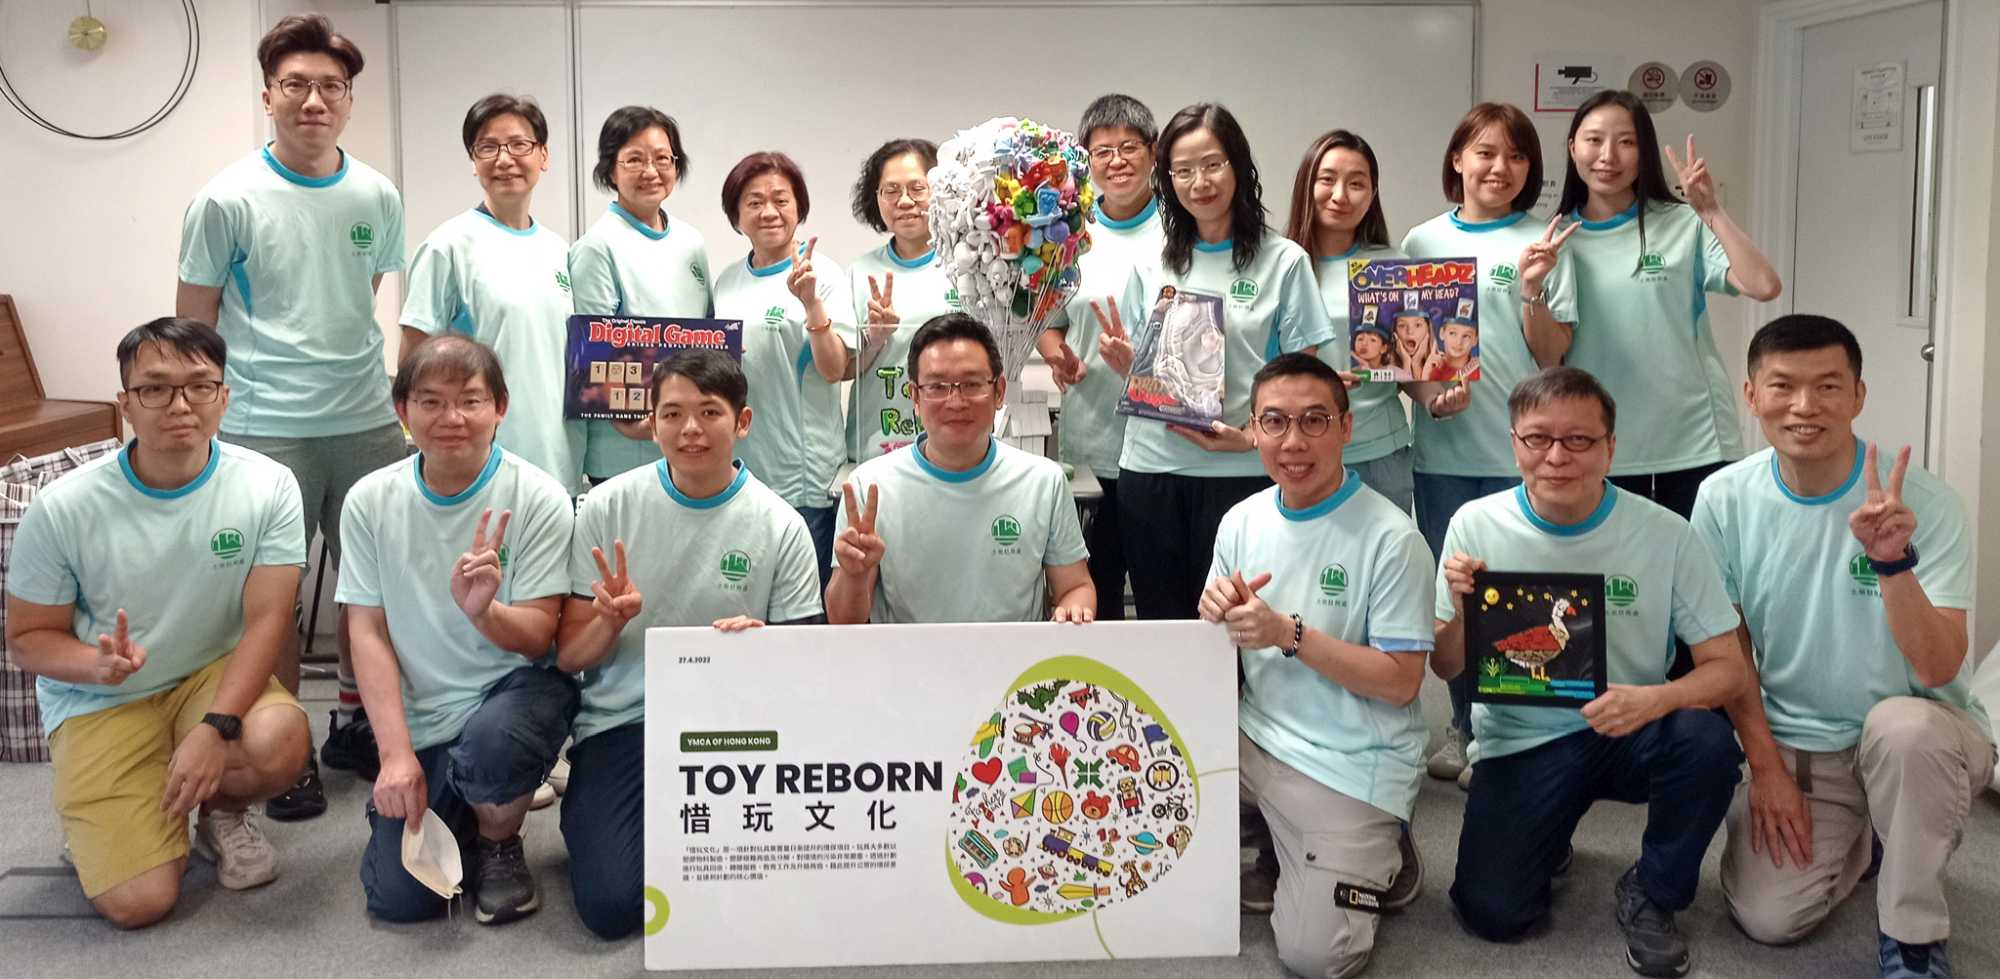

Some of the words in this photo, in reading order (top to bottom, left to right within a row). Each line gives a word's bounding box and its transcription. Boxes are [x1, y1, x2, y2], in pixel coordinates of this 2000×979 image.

[1352, 261, 1475, 291] OVERHEADZ
[1357, 293, 1387, 304] WHAT'S
[1388, 291, 1399, 303] ON
[1421, 289, 1433, 301] MY
[1434, 287, 1460, 300] HEAD?
[589, 320, 661, 348] Digital
[664, 324, 726, 346] Game
[630, 366, 637, 375] 3
[633, 391, 641, 401] 2
[687, 737, 712, 747] YMCA
[712, 737, 722, 746] OF
[723, 737, 747, 746] HONG
[747, 736, 772, 746] KONG
[679, 764, 766, 796] TOY
[776, 761, 943, 794] REBORN
[679, 800, 897, 834] 惜玩文化
